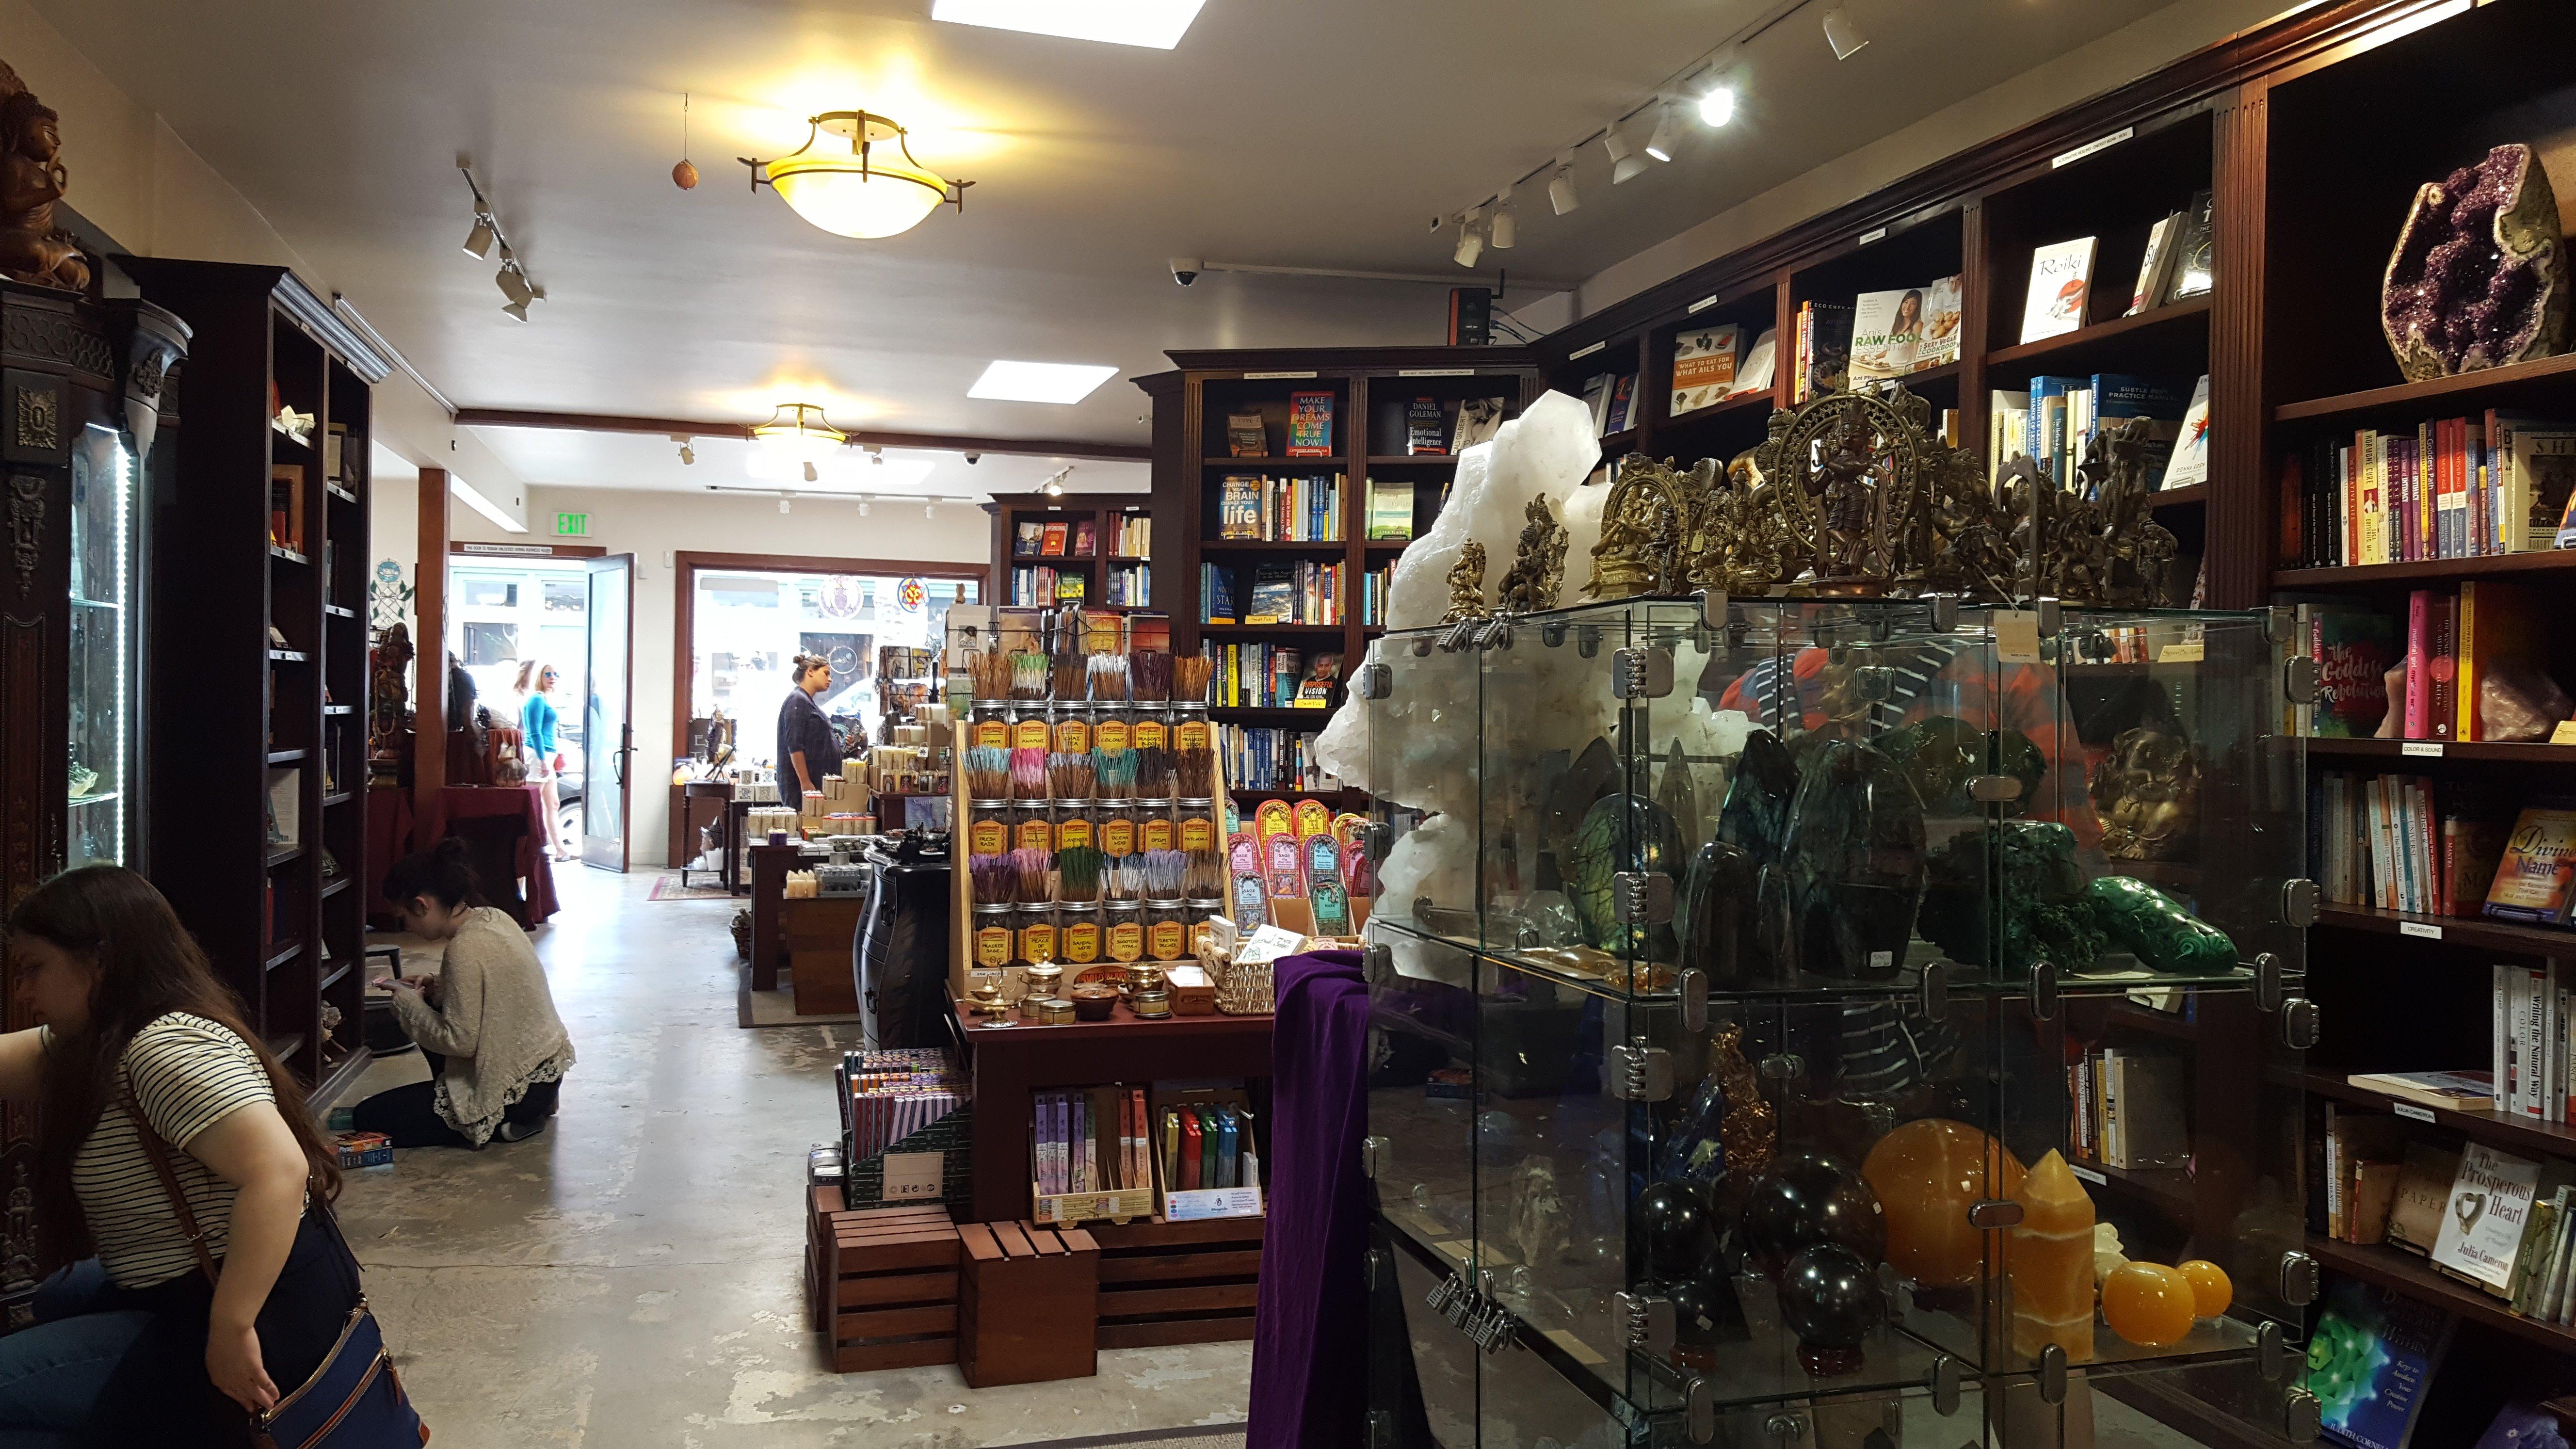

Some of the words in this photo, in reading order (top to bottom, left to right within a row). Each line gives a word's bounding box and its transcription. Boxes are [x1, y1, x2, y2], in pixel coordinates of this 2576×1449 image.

[2058, 152, 2078, 163] ALTERNATIVE
[2077, 147, 2091, 156] HEALING
[2040, 254, 2081, 275] Reiki
[1855, 335, 1885, 346] RAW
[1676, 368, 1697, 377] WHAT
[1717, 362, 1732, 370] YOU
[1410, 427, 1442, 437] Emotional
[2031, 421, 2035, 430] OF
[2176, 465, 2191, 473] DONNA
[1225, 491, 1259, 500] BRAIN
[558, 513, 587, 534] EXIT
[1223, 505, 1257, 524] life
[1217, 596, 1234, 605] STAR
[2322, 654, 2384, 681] Goddess
[2321, 680, 2387, 703] Revolution
[2409, 818, 2417, 856] UNIVERSE
[2509, 825, 2576, 856] Divine
[2516, 856, 2561, 875] Name
[2408, 926, 2435, 935] CREATIVITY
[1106, 972, 1127, 982] BERRY
[2531, 996, 2541, 1026] Writing
[2532, 1028, 2541, 1043] the
[2531, 1046, 2540, 1078] Natural
[2529, 1080, 2539, 1098] Way
[2409, 1109, 2434, 1120] CAMERON
[2479, 1152, 2498, 1172] The
[2461, 1160, 2532, 1201] Prosperous
[2401, 1188, 2447, 1213] PAPER
[2489, 1195, 2523, 1224] Heart
[2458, 1241, 2479, 1259] Julia
[2479, 1249, 2509, 1272] Cameron
[2392, 1369, 2416, 1383] Awaken
[2398, 1383, 2413, 1393] Your
[2330, 1422, 2356, 1439] JUDITH
[2356, 1435, 2389, 1449] CORNEL
